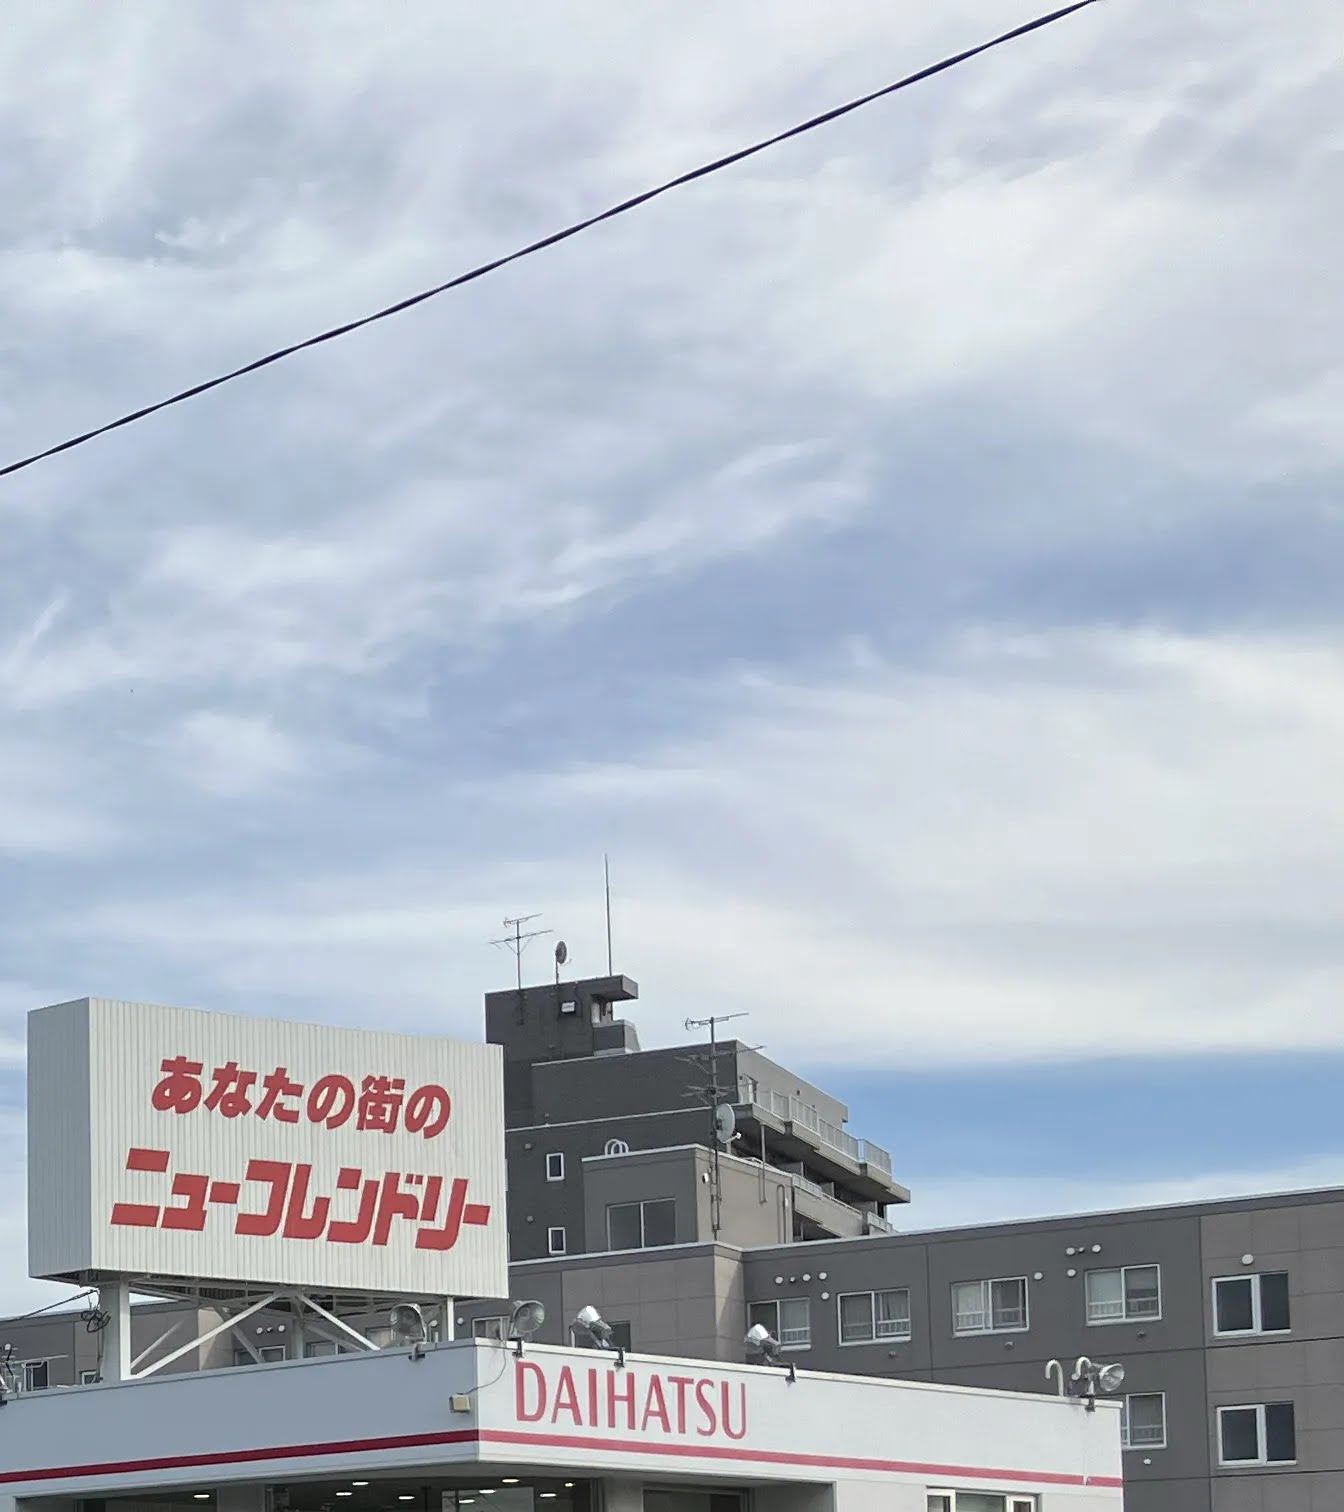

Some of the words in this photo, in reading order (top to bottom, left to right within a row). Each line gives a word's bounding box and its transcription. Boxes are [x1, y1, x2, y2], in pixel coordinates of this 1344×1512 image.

[151, 1055, 451, 1140] あなたの街の
[111, 1147, 491, 1251] ニューフレンドリー
[514, 1360, 748, 1440] DAIHATSU
